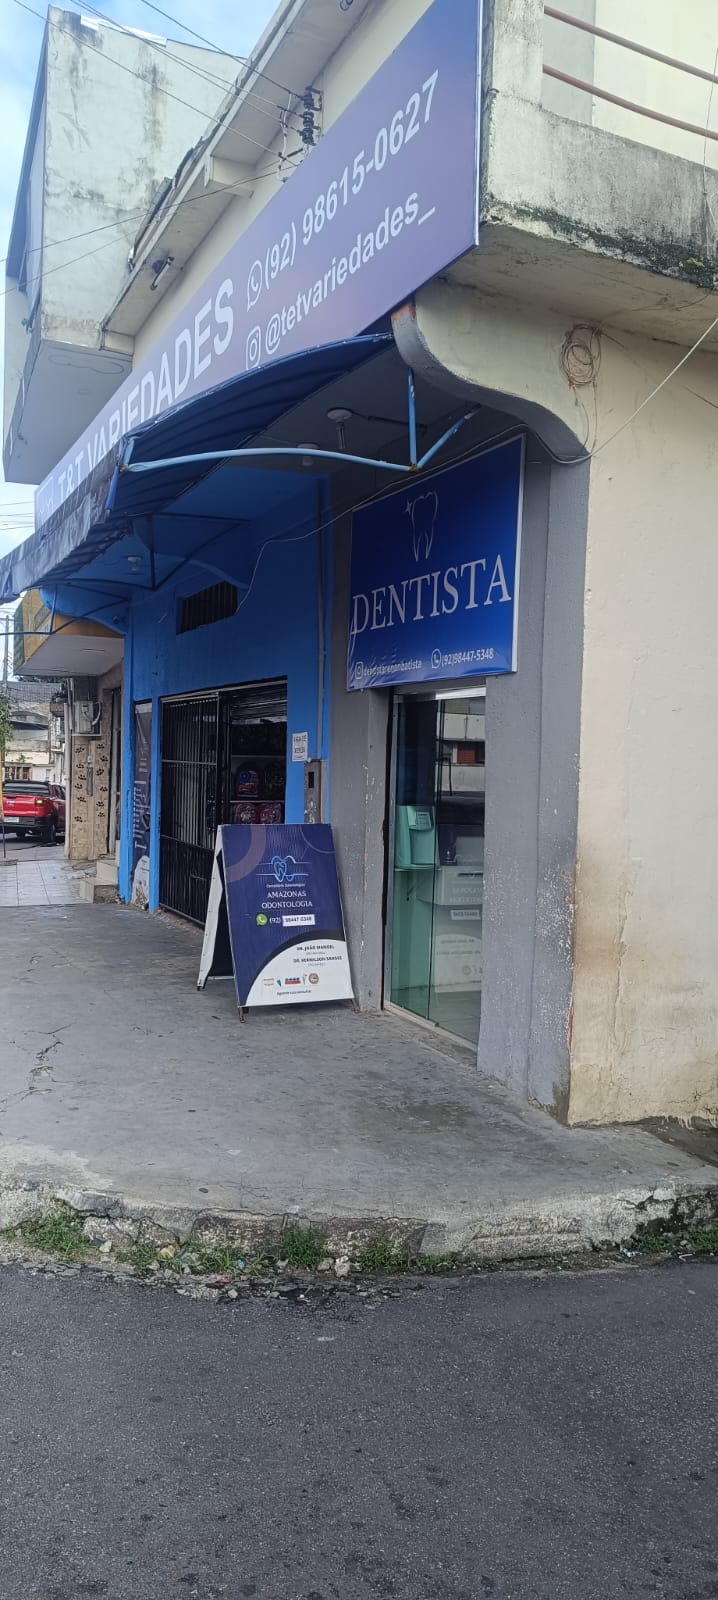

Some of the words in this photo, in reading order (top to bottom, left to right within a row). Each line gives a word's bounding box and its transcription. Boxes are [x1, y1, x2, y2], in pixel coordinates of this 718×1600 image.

[264, 222, 297, 289] (92)
[303, 69, 439, 246] 98615-0627
[265, 191, 437, 356] @tetvariedades_
[57, 449, 85, 500] T&T
[86, 277, 235, 471] VARIEDADES
[350, 554, 512, 636] DENTISTA
[261, 900, 313, 909] ODONTOLOGIA
[267, 890, 307, 899] AMAZONAS
[269, 916, 281, 924] (92)
